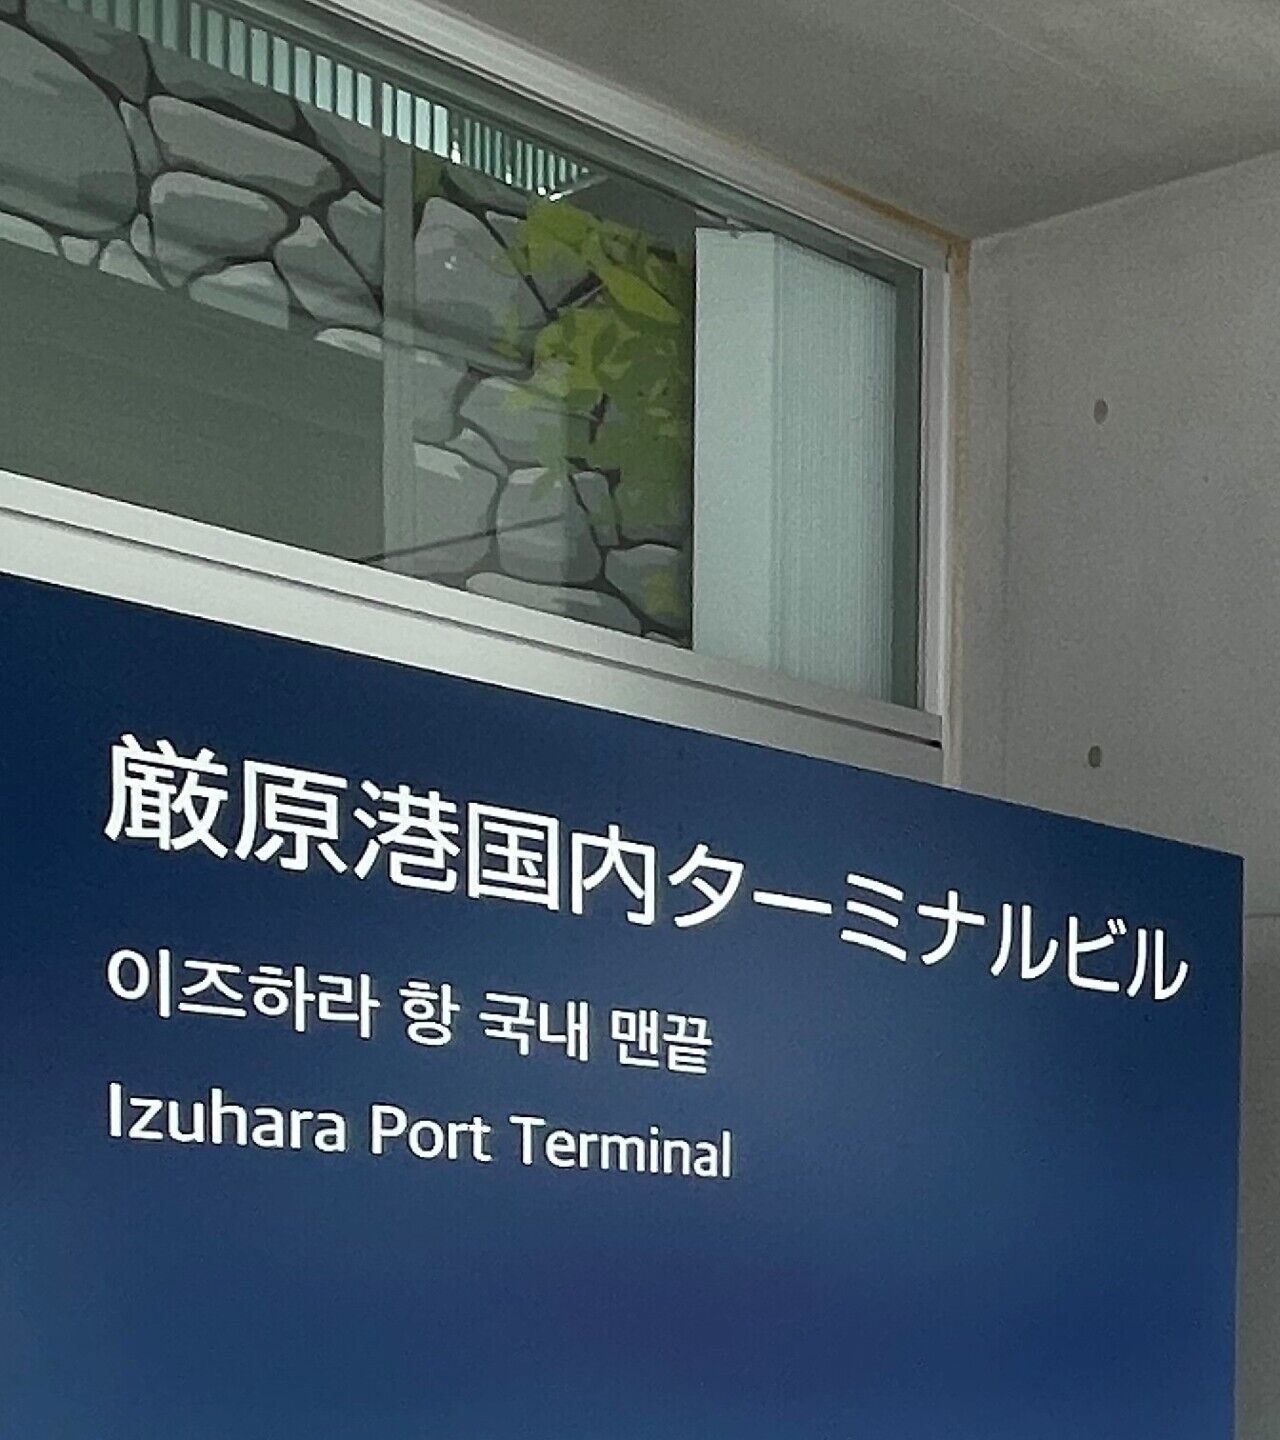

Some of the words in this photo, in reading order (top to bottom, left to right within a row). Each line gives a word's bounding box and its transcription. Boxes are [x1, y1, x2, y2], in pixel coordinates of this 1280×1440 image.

[104, 732, 1190, 1002] 厳原港国内ターミナルビル
[106, 948, 382, 1039] 이즈하라
[398, 981, 462, 1046] 항
[477, 991, 589, 1063] 국내
[611, 1009, 715, 1074] 맨끝
[108, 1082, 347, 1153] Izuhara
[370, 1104, 494, 1162] Port
[509, 1115, 732, 1178] Terminal
